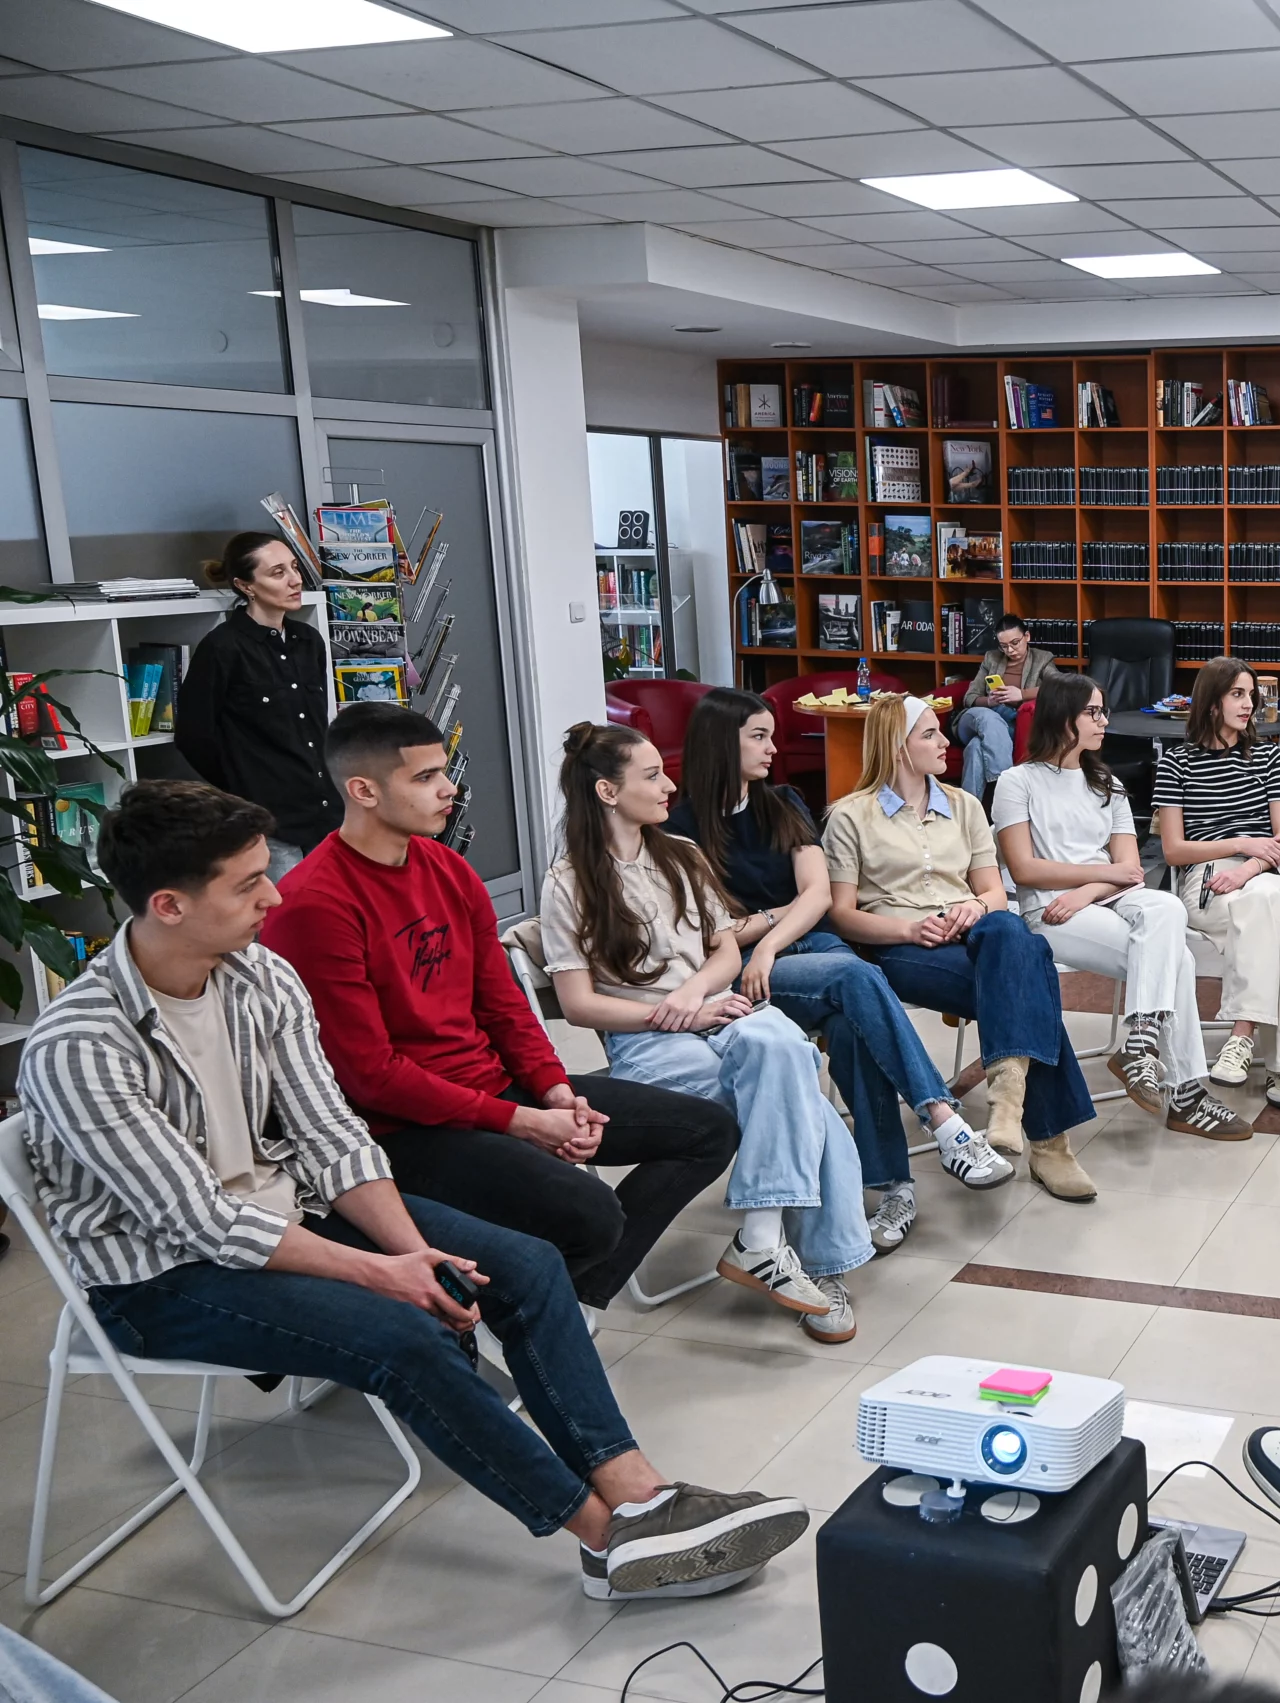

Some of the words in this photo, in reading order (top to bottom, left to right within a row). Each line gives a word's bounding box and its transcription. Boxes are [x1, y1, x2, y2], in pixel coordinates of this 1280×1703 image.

[950, 444, 965, 452] New
[966, 444, 983, 453] York
[329, 512, 380, 525] TIME
[332, 552, 351, 561] NEW
[351, 552, 388, 561] YORKER
[804, 551, 829, 560] Rivers
[335, 592, 355, 600] NEW
[355, 591, 392, 600] YORKER
[333, 629, 401, 646] DOWNBEAT
[58, 823, 100, 838] TRUS
[896, 1389, 952, 1399] acer
[915, 1434, 942, 1445] acer
